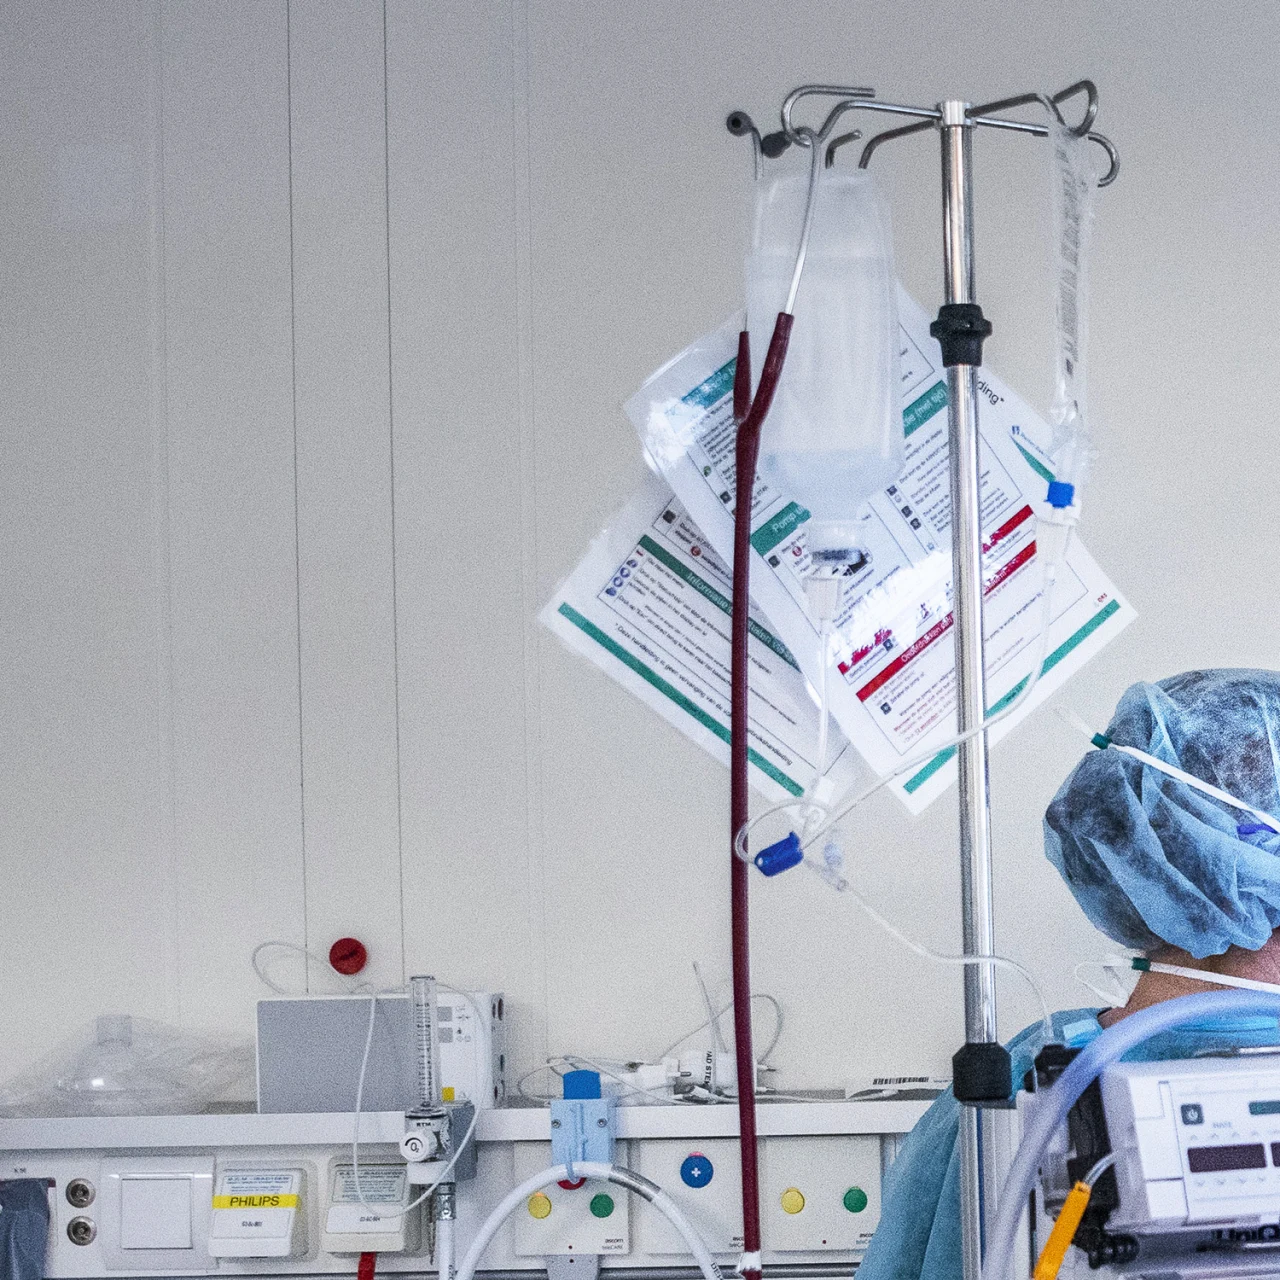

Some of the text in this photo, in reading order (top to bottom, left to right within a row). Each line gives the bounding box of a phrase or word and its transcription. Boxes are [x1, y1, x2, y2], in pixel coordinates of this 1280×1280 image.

[769, 510, 798, 534] Pomp
[683, 570, 732, 610] Informatie
[615, 624, 633, 640] Deze
[629, 635, 661, 663] handleiding
[663, 662, 679, 677] geen
[676, 672, 707, 699] vervanging
[229, 1196, 280, 1207] PHILIPS
